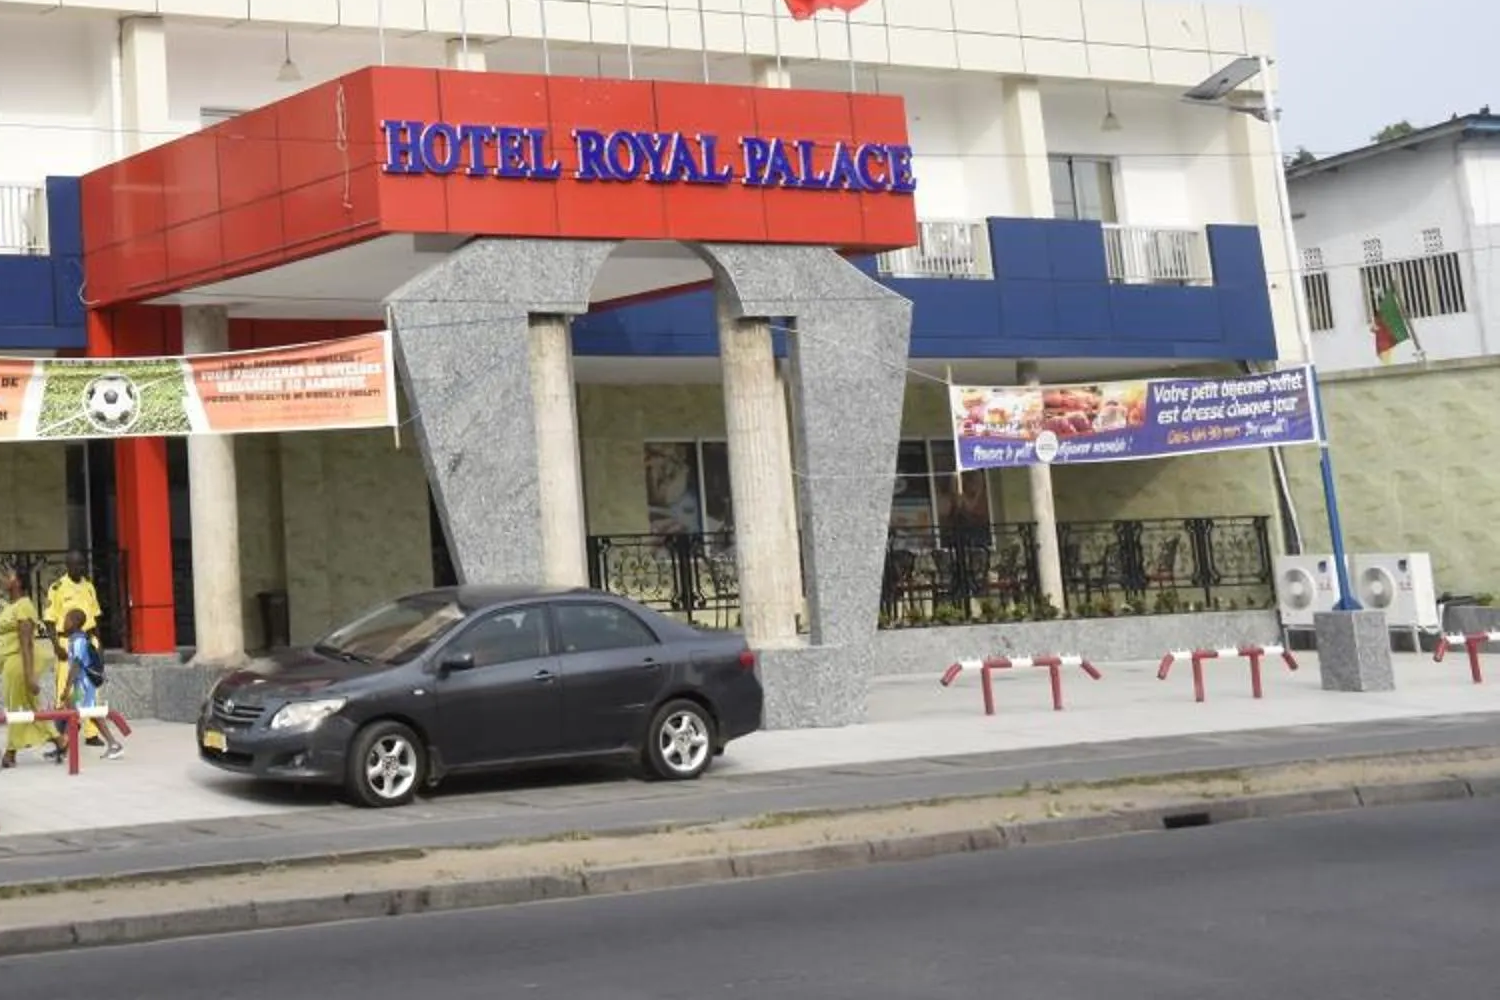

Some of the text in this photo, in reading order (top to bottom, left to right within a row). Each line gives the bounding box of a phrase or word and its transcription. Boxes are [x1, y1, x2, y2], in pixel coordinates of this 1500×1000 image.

[381, 119, 916, 193] HOTEL ROYAL PALACE
[1, 376, 19, 388] DE
[1153, 384, 1189, 404] Votre
[1190, 381, 1219, 404] petit
[1157, 406, 1179, 425] est
[1227, 398, 1271, 420] chaque
[1272, 396, 1299, 417] jour
